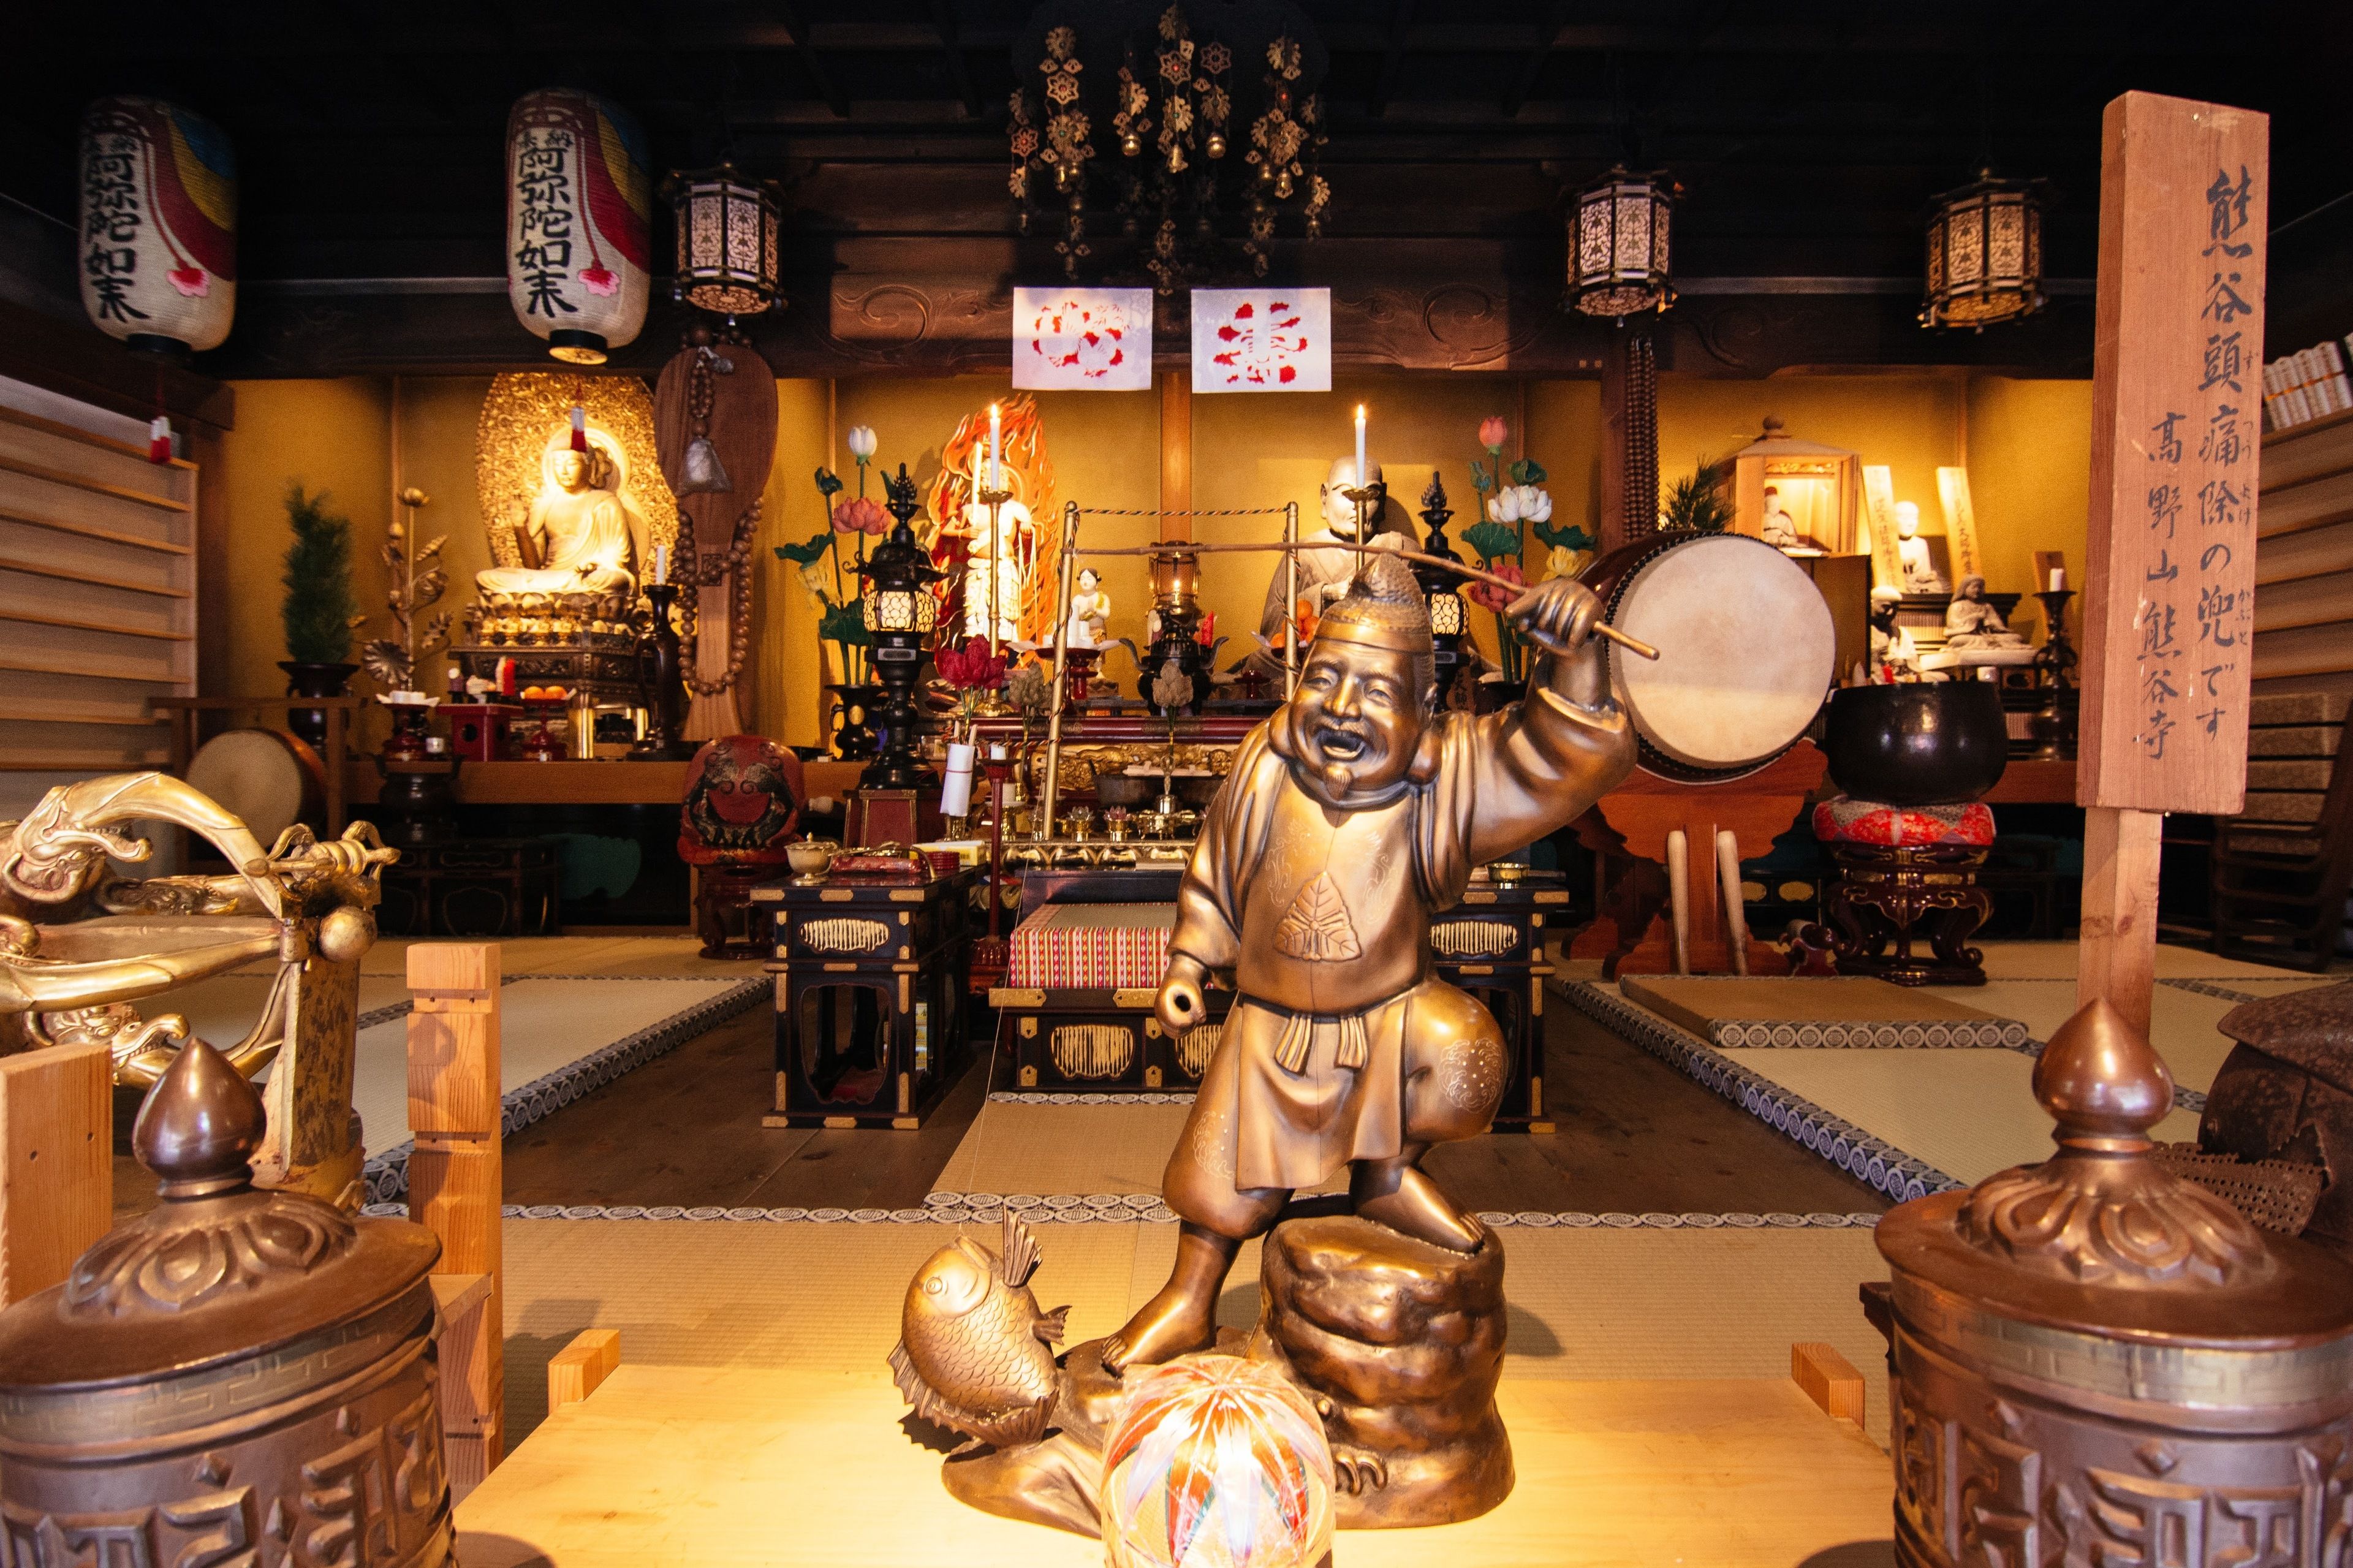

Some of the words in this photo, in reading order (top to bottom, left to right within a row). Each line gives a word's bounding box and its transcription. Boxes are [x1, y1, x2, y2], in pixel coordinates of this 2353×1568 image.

[515, 148, 580, 319] 阿弥陀如来
[2196, 163, 2253, 743] 熊谷頭痛除の兜です
